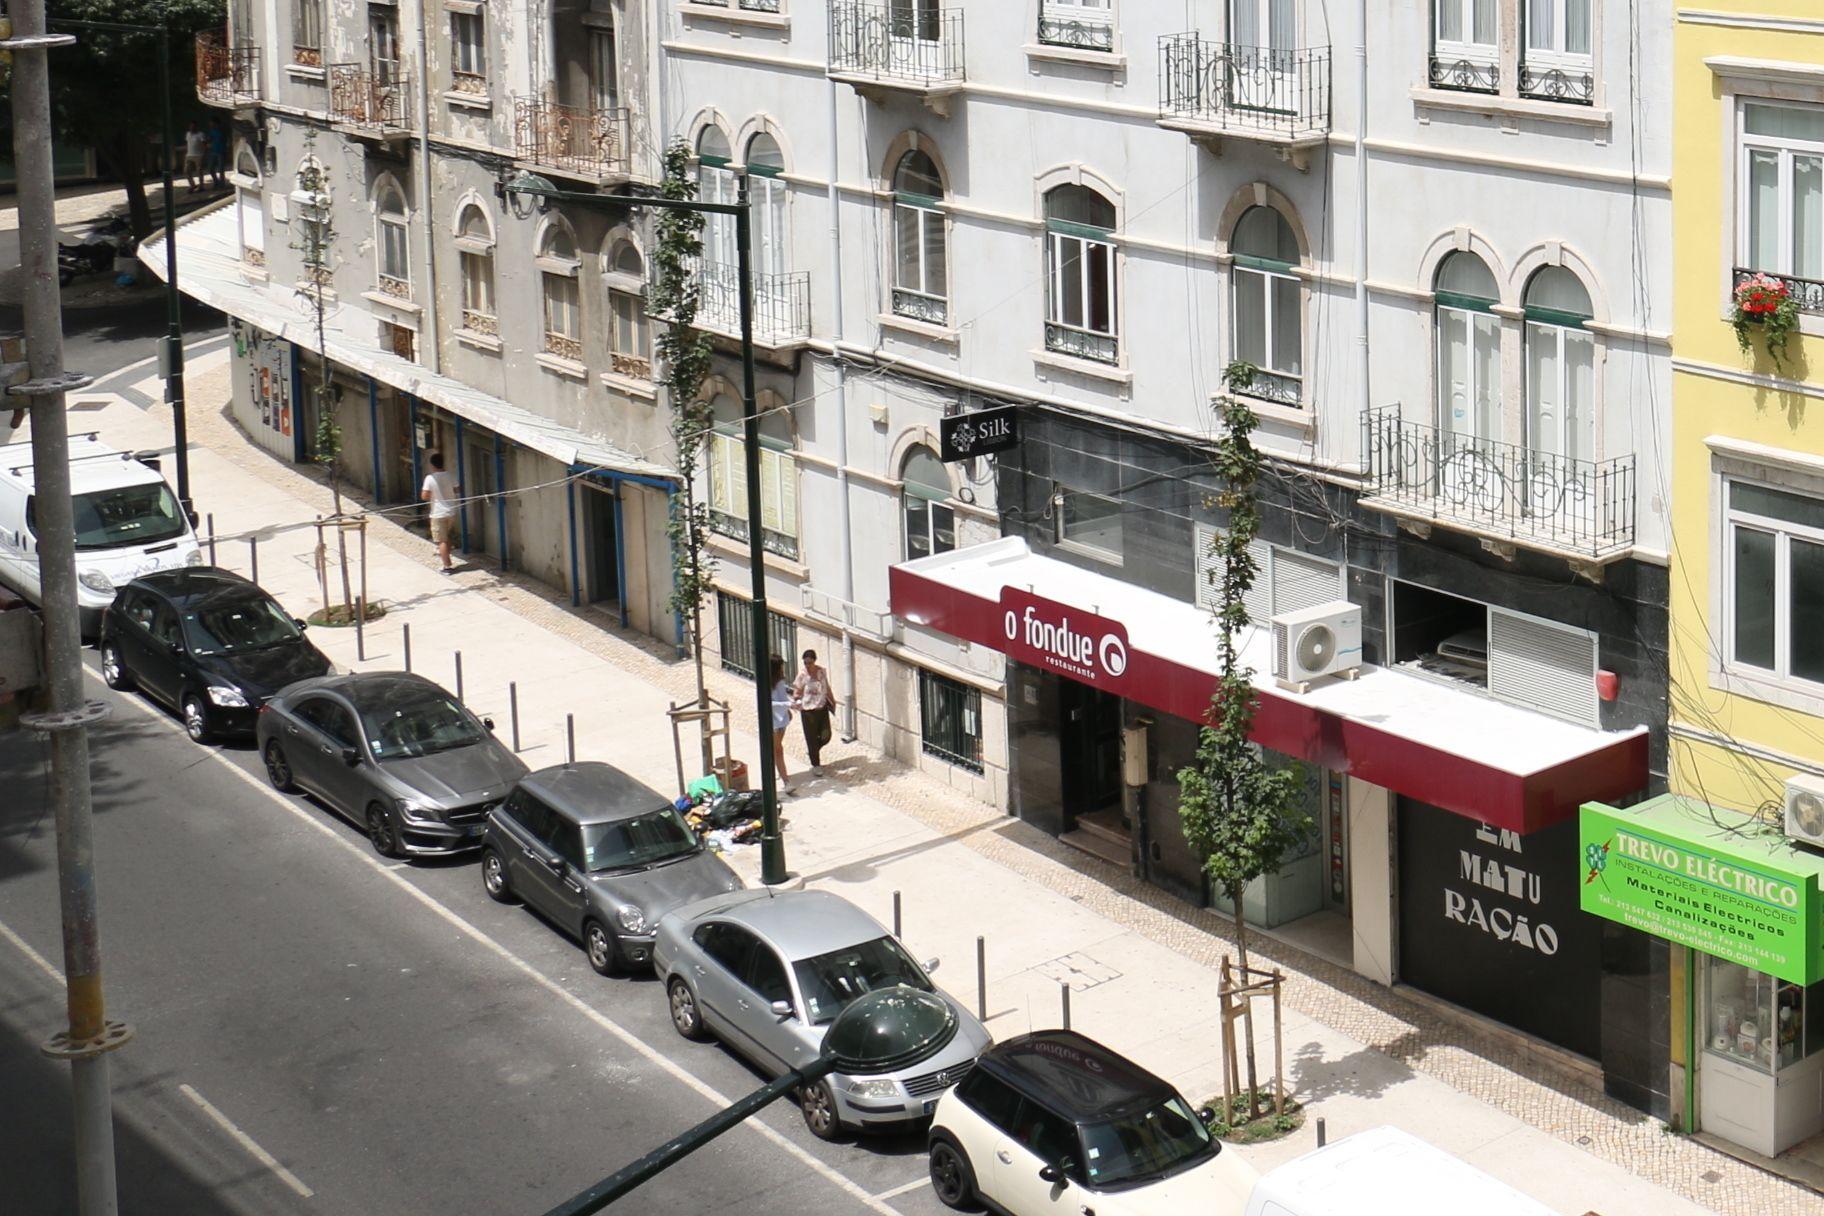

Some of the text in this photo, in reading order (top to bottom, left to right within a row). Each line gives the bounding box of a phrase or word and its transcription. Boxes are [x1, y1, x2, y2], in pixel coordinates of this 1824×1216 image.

[979, 418, 1010, 439] Silk
[1005, 606, 1093, 666] o fondue
[1046, 656, 1095, 679] restaurante
[1460, 850, 1541, 904] MATU
[1616, 832, 1798, 906] TREVO ELÉCTRICO
[1616, 859, 1797, 925] INSTALAÇÕES E REPARAÇÕES
[1445, 888, 1558, 955] RAÇÃO
[1627, 876, 1784, 937] Materiais Electricos
[1655, 899, 1755, 941] Canalizações
